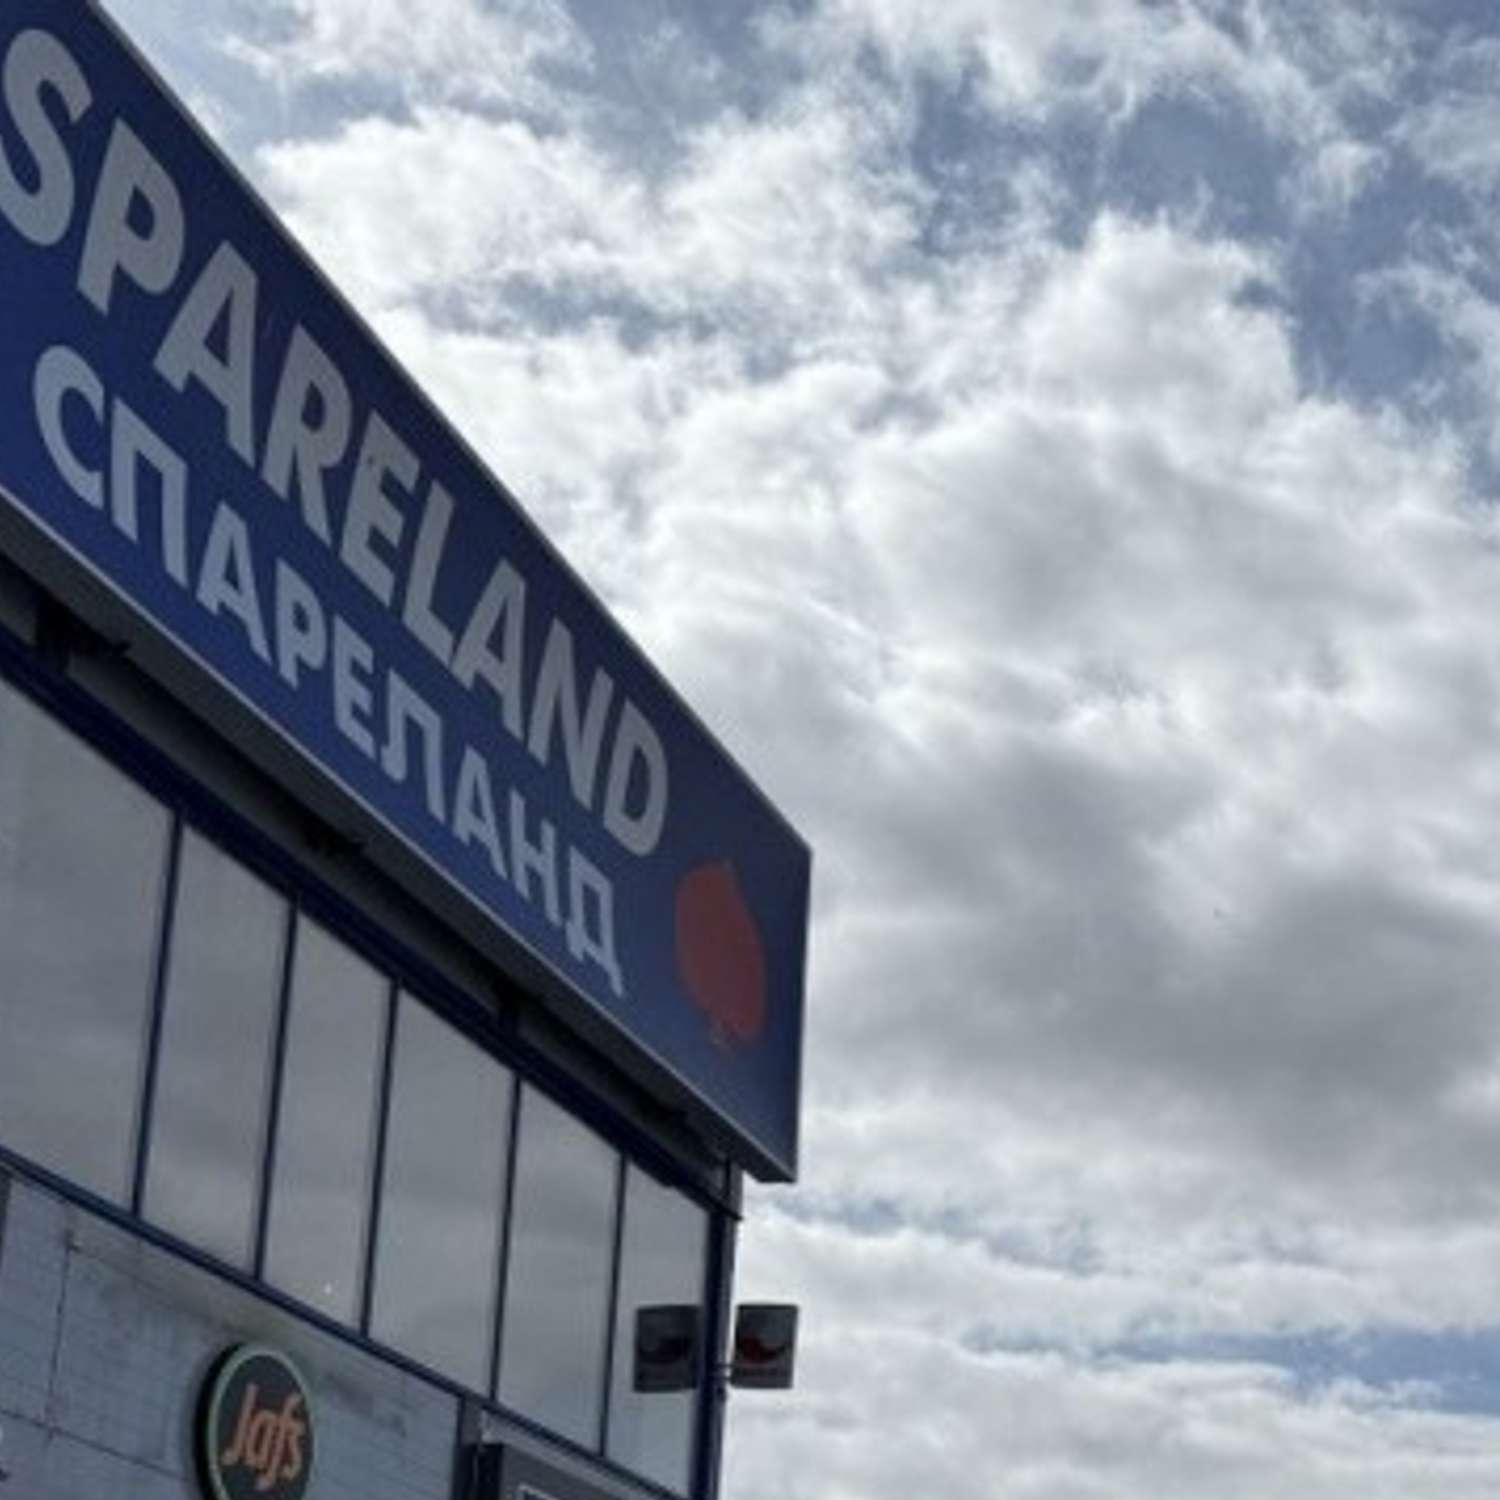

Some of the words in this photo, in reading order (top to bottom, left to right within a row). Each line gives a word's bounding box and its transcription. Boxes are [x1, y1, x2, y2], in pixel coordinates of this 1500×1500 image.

[0, 28, 669, 856] SPARELAND
[33, 345, 625, 997] СПАРЕЛАНД
[221, 1384, 306, 1491] Jafs
